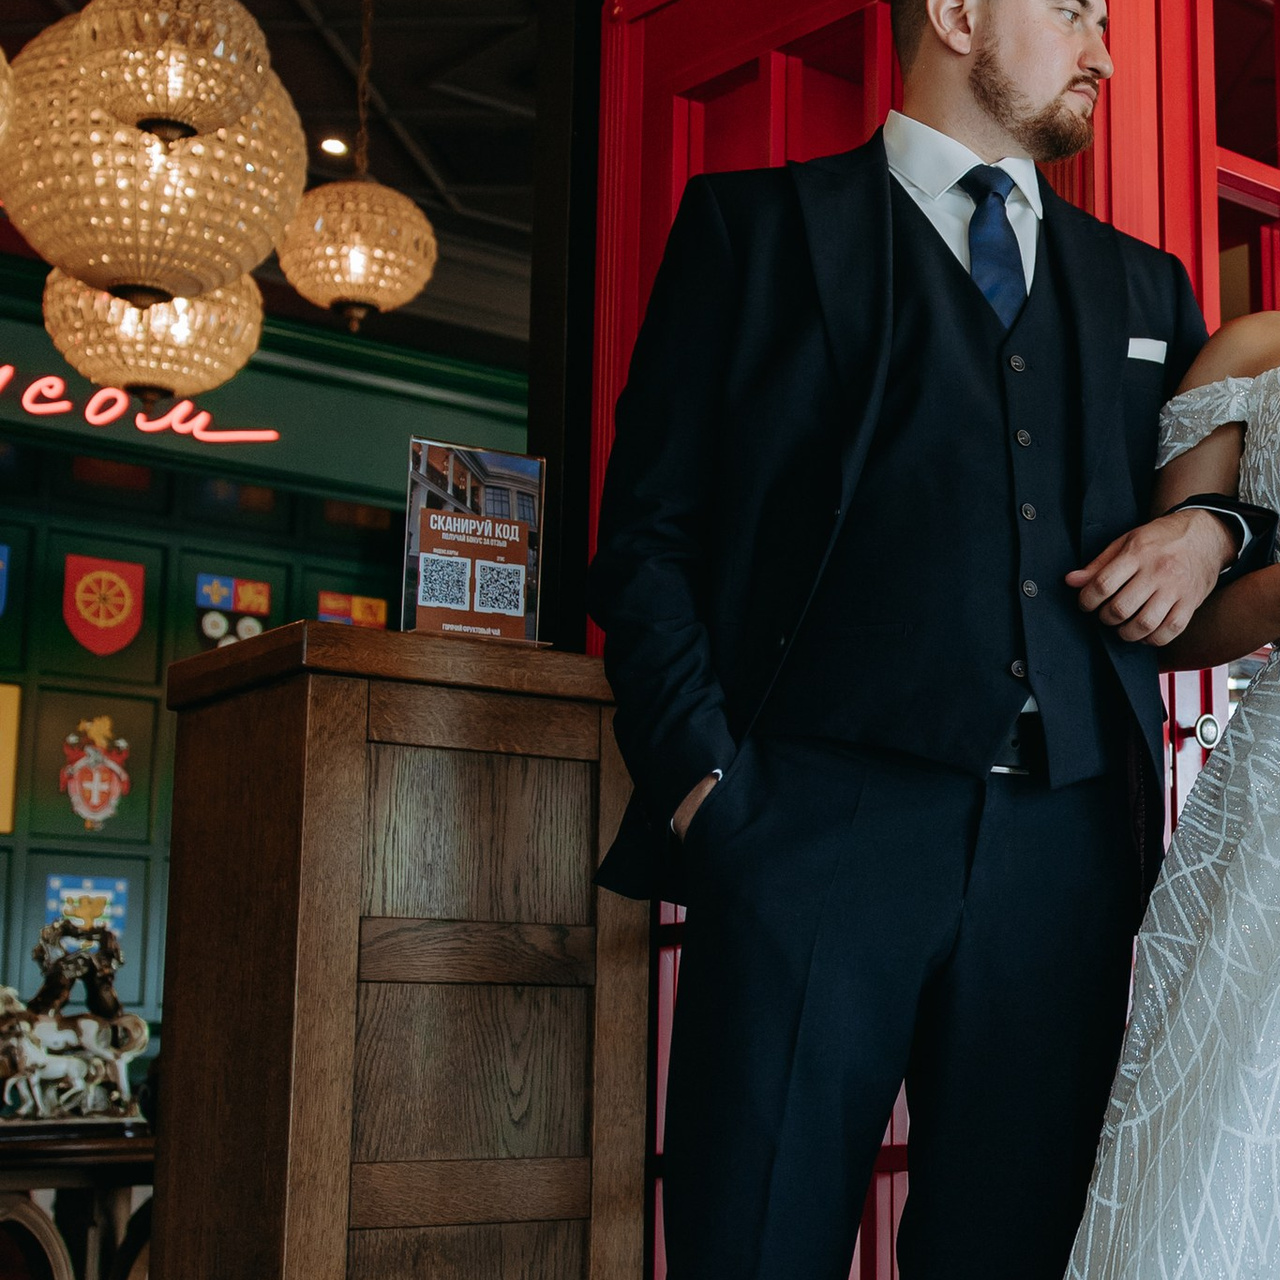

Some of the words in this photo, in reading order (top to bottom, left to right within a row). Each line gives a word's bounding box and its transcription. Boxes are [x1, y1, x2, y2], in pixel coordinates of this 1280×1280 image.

[430, 514, 493, 537] СКАНИРУЙ
[495, 523, 520, 542] КОД
[466, 535, 483, 545] БОНУС
